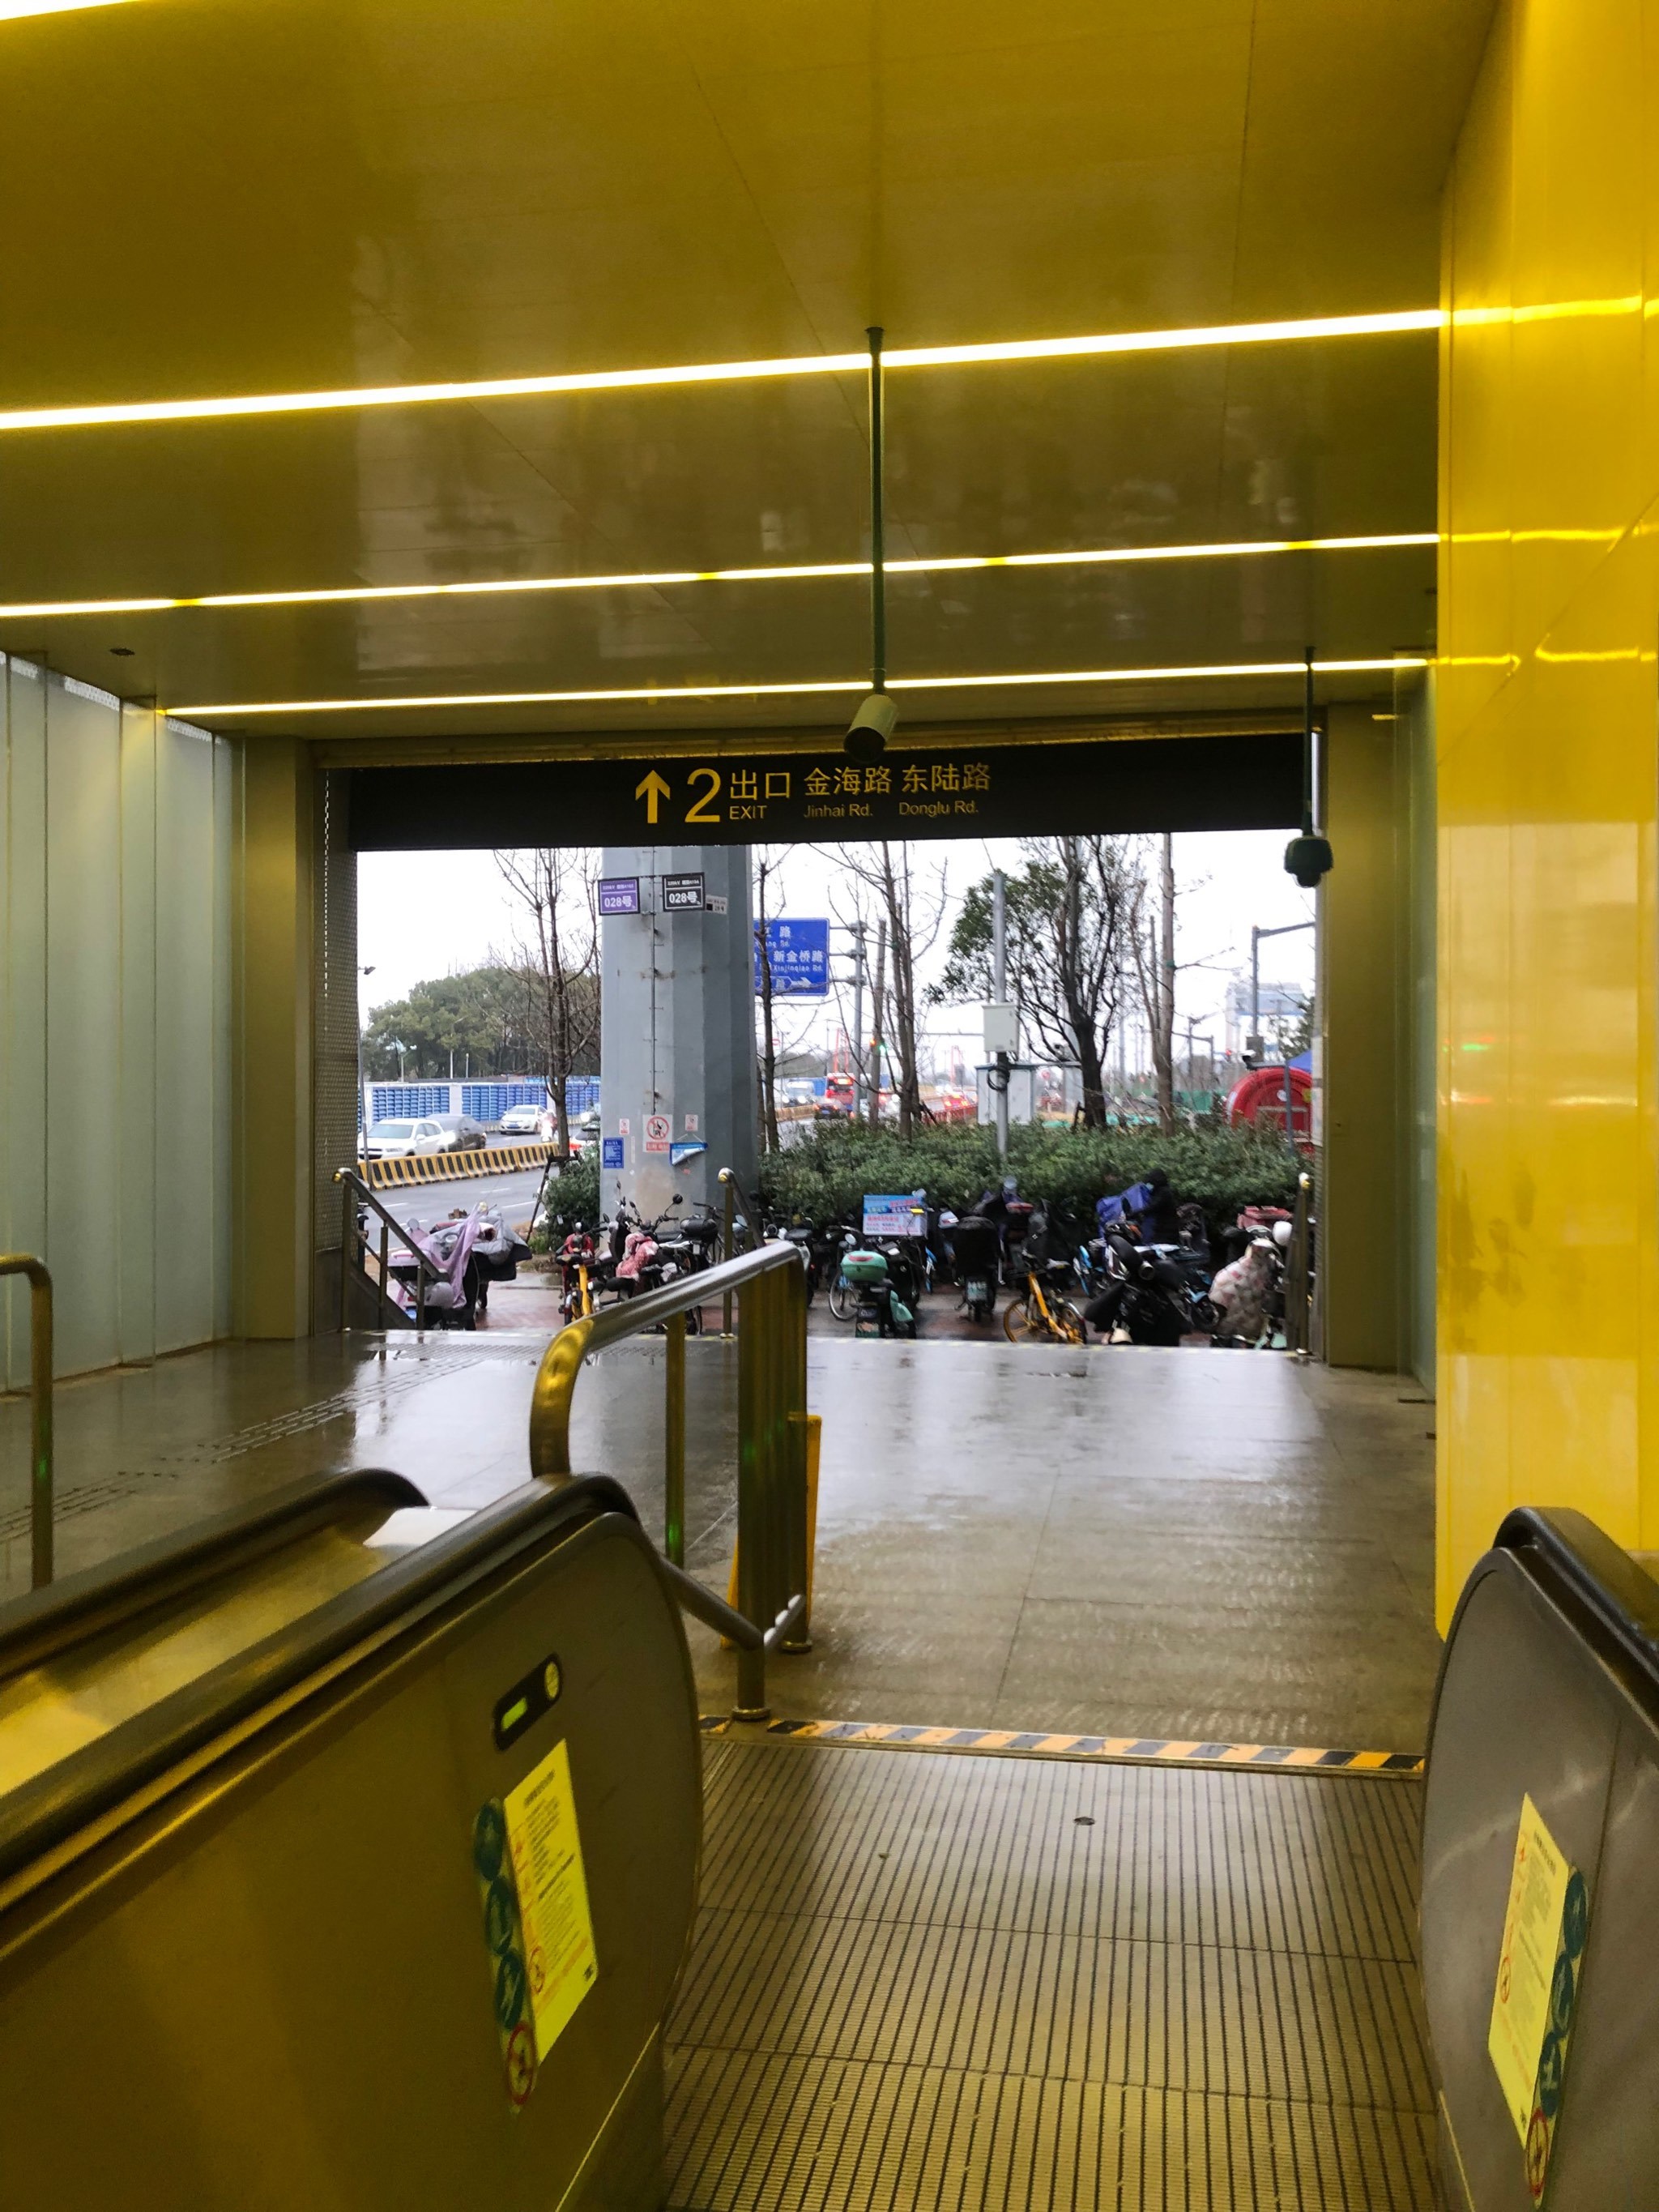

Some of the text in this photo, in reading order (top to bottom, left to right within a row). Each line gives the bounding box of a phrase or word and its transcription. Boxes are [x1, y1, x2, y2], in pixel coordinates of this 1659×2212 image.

[730, 769, 791, 800] 出口
[804, 762, 992, 796] 金海路 东陆路
[684, 768, 721, 822] 2
[730, 805, 767, 820] EXIT
[804, 802, 873, 818] Jinhai Rd.
[899, 799, 979, 819] Donglu Rd.
[604, 895, 633, 908] 028号
[669, 891, 697, 903] 028号
[773, 950, 824, 963] 新金桥路
